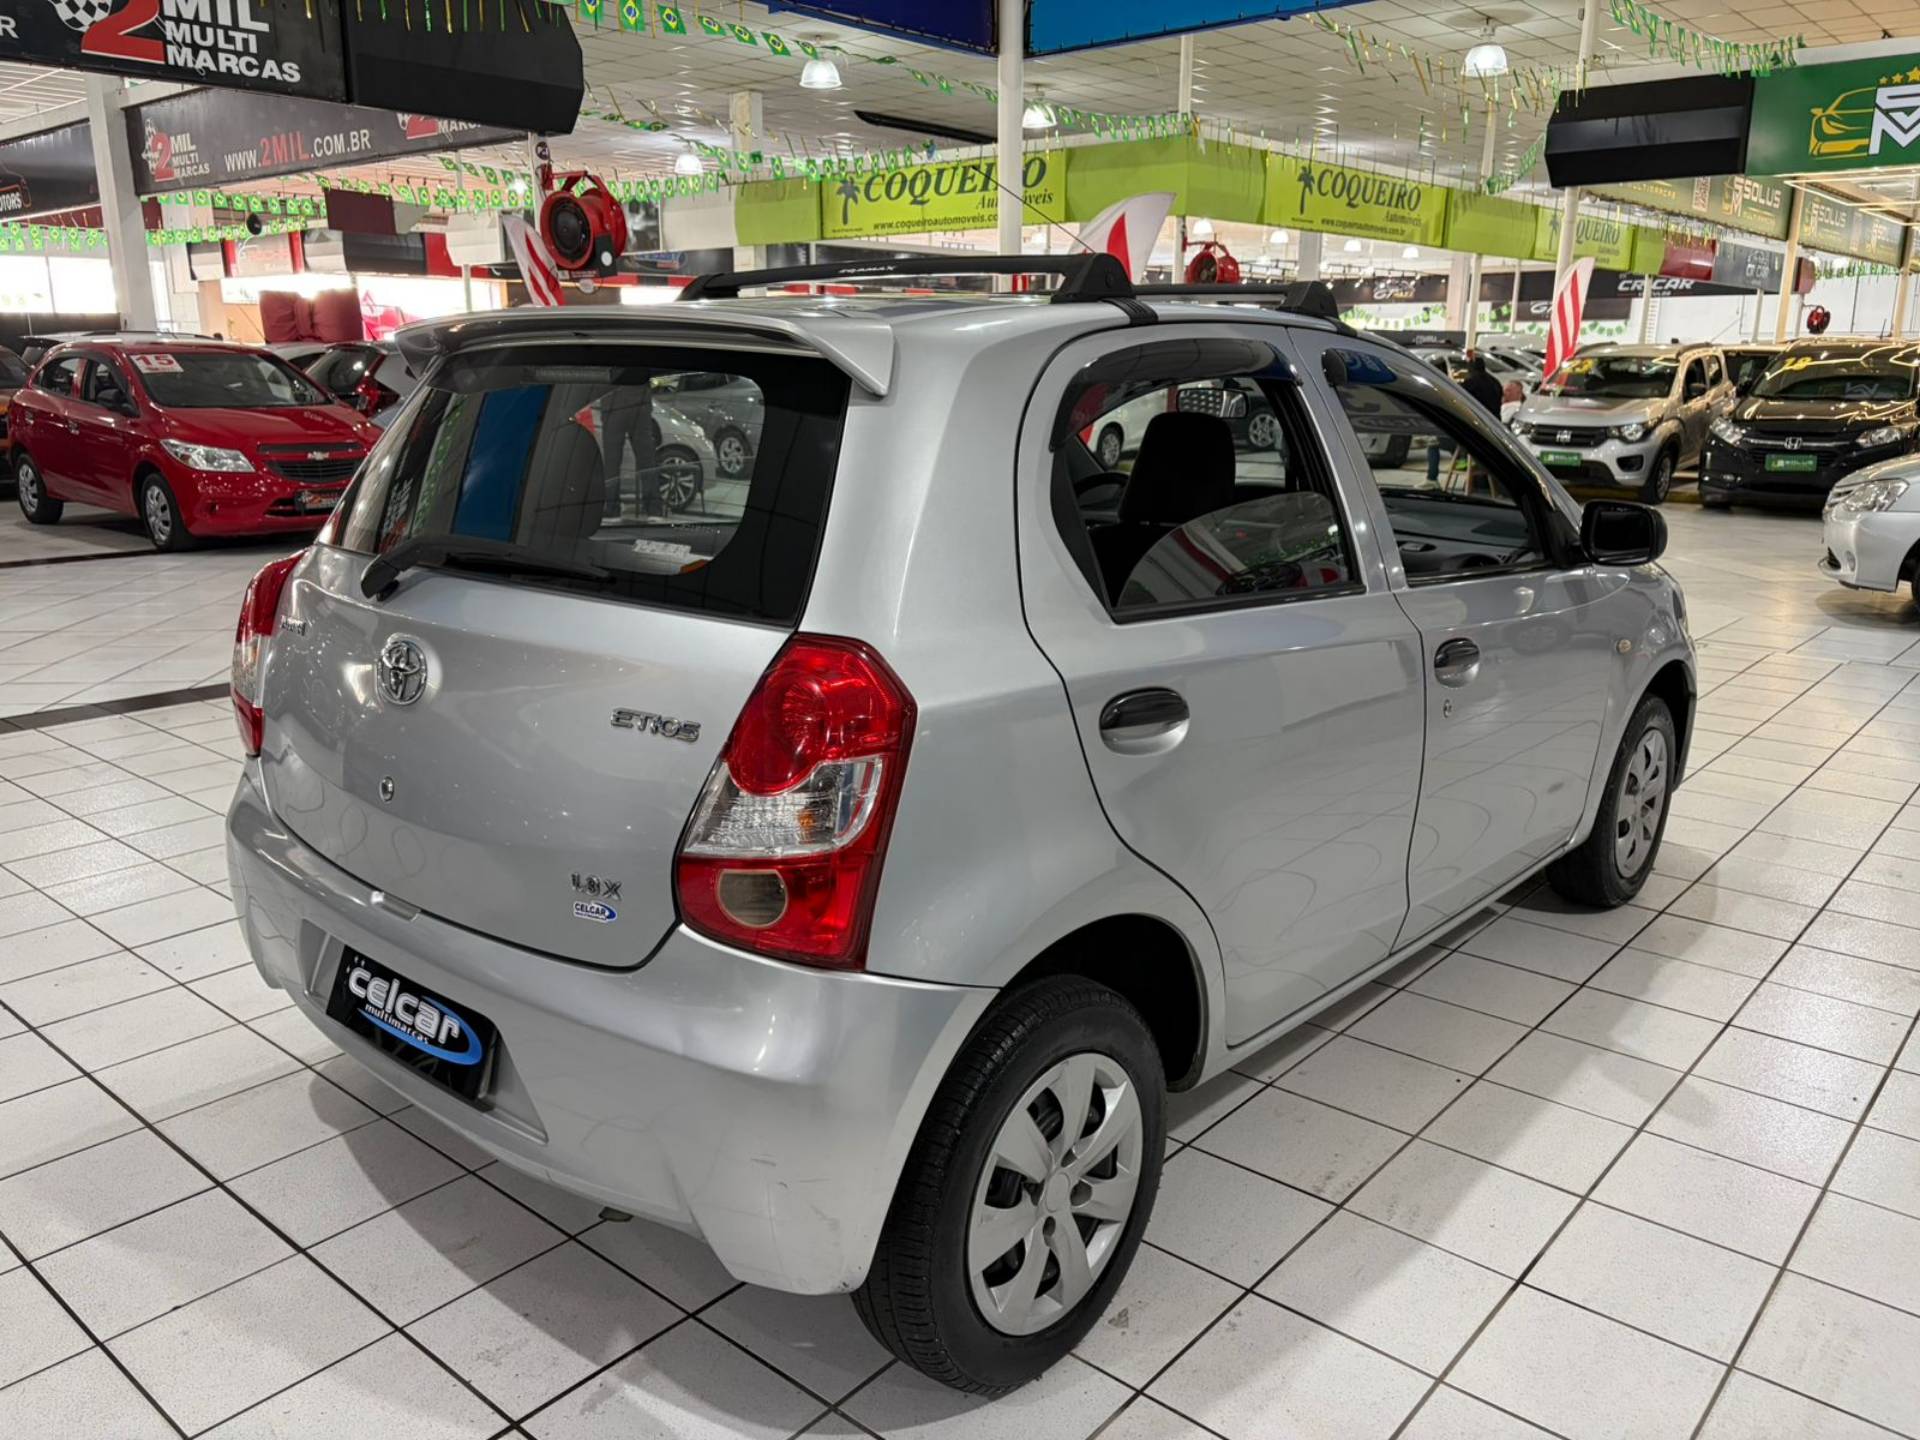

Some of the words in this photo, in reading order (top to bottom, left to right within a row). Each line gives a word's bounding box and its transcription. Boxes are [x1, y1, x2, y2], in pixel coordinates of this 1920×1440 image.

[165, 20, 258, 54] MULTI
[166, 45, 301, 83] MARCAS
[438, 118, 481, 134] MAR
[170, 133, 197, 155] MIL
[172, 151, 199, 169] MULTI
[224, 128, 372, 172] WWW.2MIL.COM.BR
[173, 162, 210, 180] MARCAS
[864, 156, 1047, 205] COQUEIO
[1317, 168, 1422, 212] COQUEIRO
[1576, 219, 1621, 245] QUEIRO
[135, 354, 175, 368] 15
[611, 707, 701, 743] ETIOS
[574, 902, 607, 916] CELCAR
[348, 966, 460, 1044] celcar
[364, 1003, 429, 1045] multimarcas
